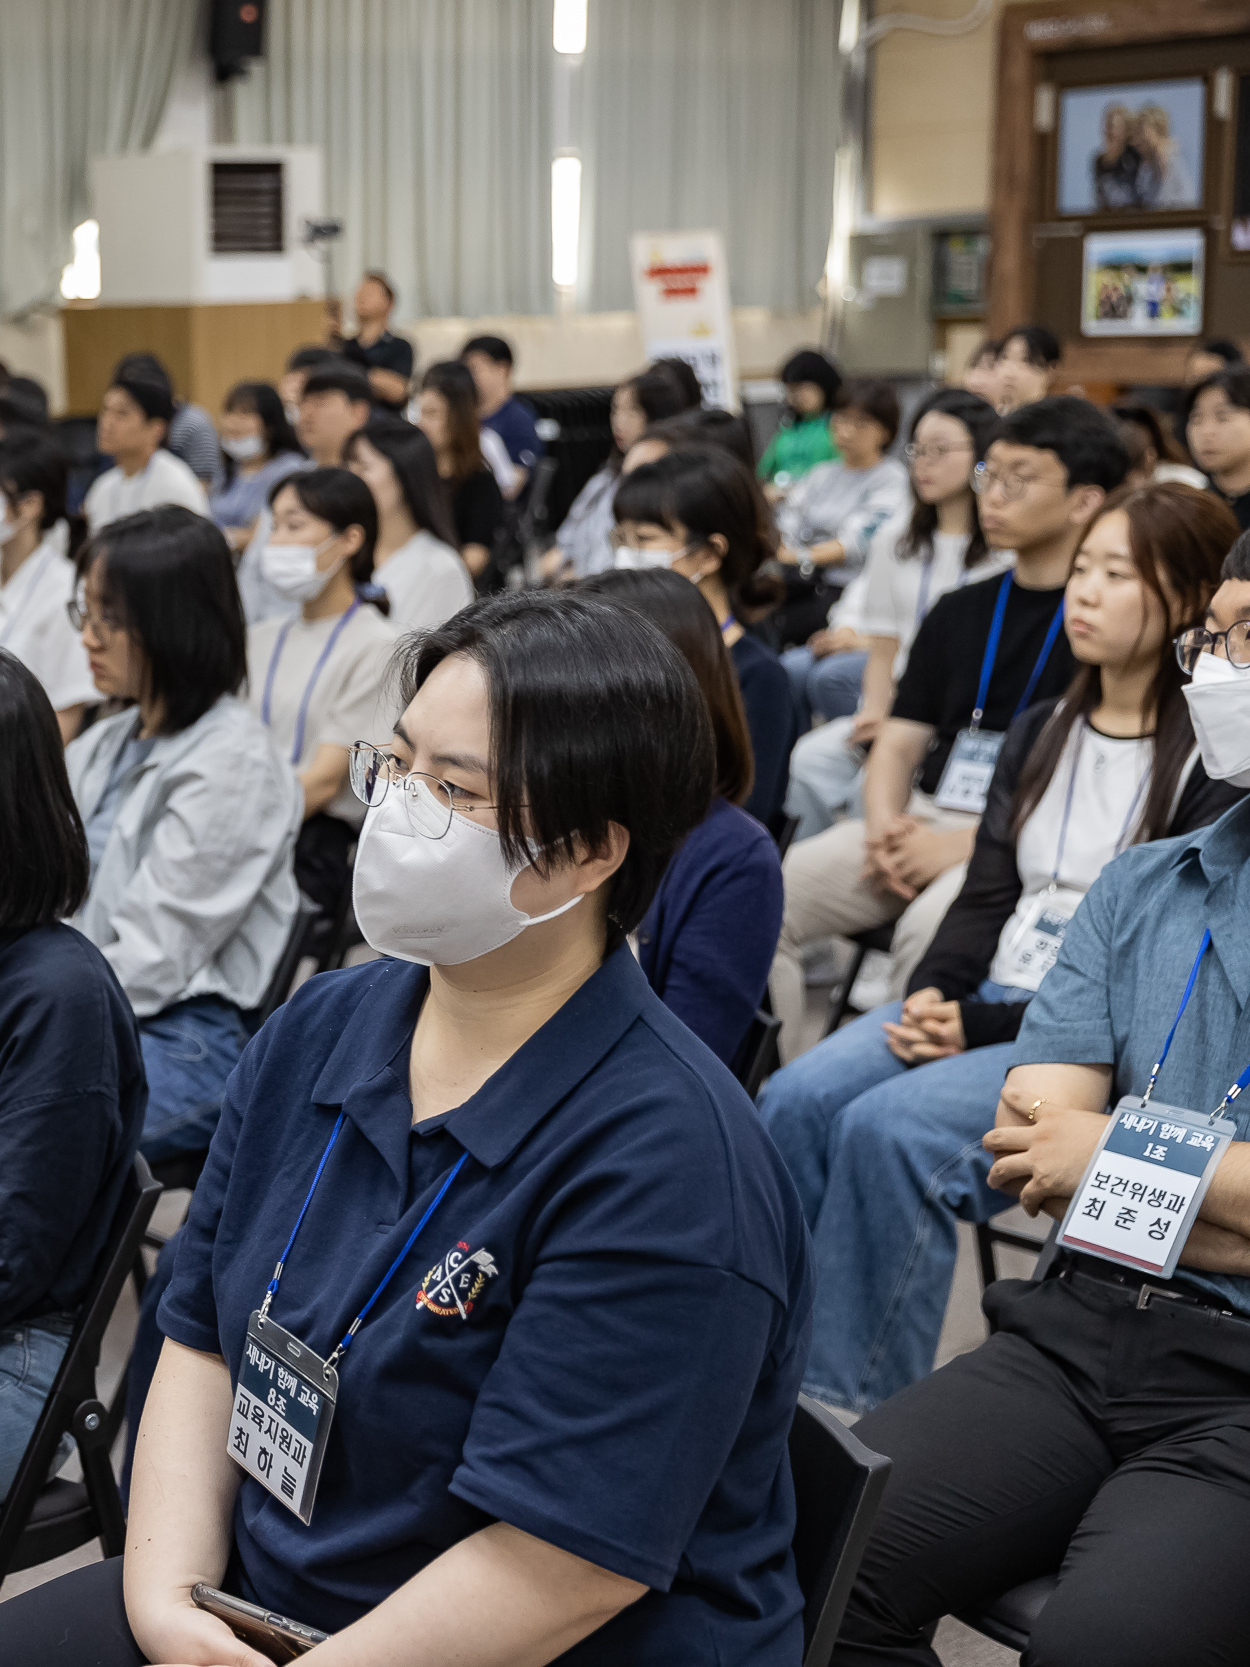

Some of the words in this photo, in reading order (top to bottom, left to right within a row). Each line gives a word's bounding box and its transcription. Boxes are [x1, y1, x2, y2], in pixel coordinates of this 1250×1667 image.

[1119, 1113, 1158, 1135] 새내기
[1158, 1122, 1187, 1143] 함께
[1186, 1131, 1215, 1151] 교육
[1142, 1142, 1168, 1160] 1조
[1090, 1171, 1186, 1214] 보건위생과
[246, 1343, 275, 1379] 새내기
[277, 1367, 297, 1397] 함께
[297, 1385, 318, 1415] 교육
[267, 1388, 286, 1415] 8조
[236, 1392, 306, 1468] 교육지원과
